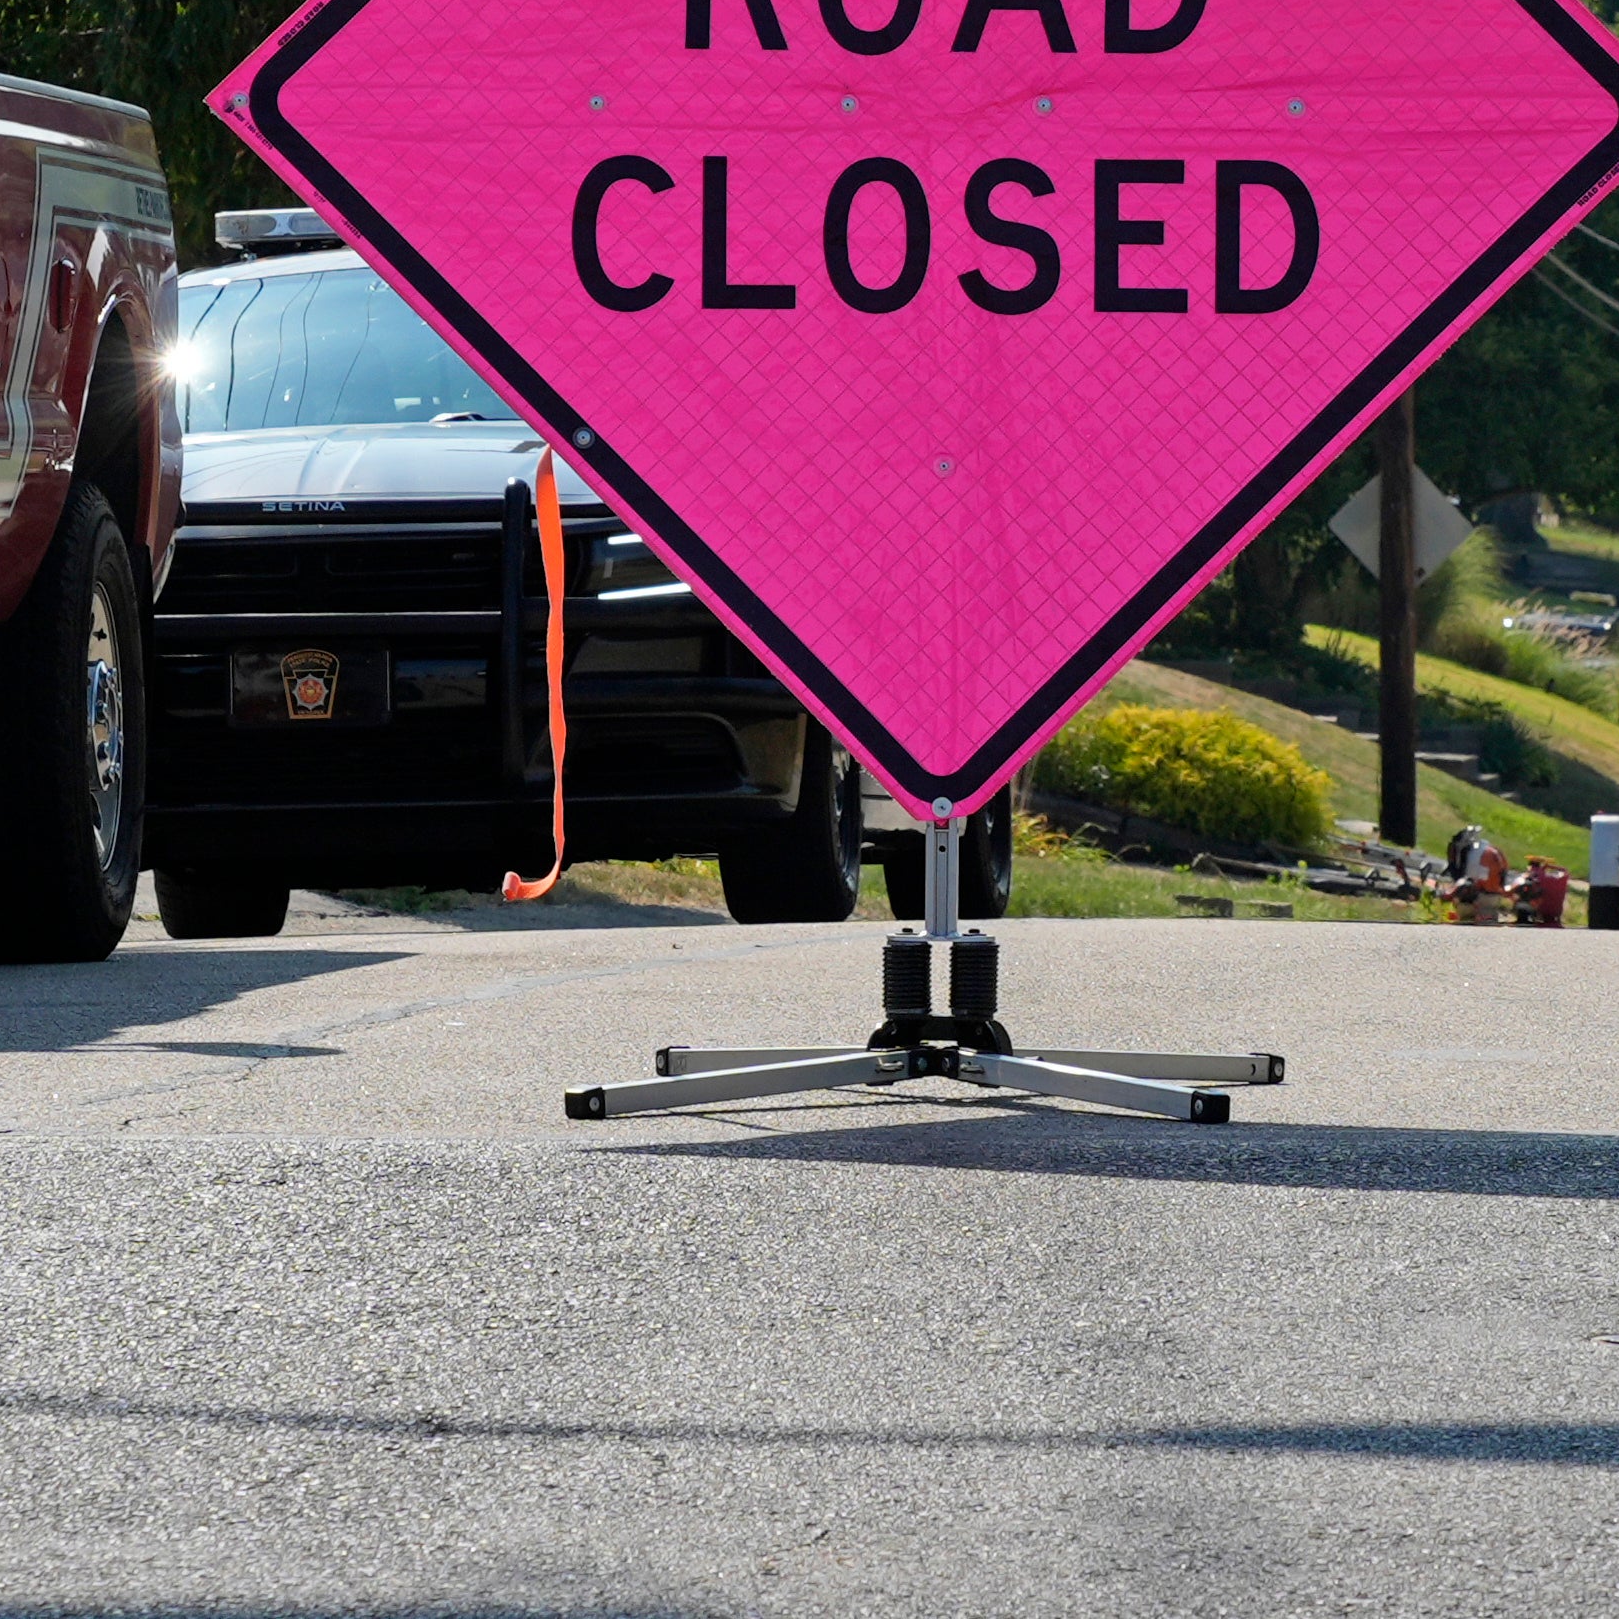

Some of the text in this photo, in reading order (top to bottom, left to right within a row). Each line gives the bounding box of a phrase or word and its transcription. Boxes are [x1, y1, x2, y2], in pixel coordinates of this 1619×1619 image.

[1577, 187, 1599, 207] ROAD
[571, 154, 1320, 315] CLOSED
[261, 501, 346, 513] SETINA
